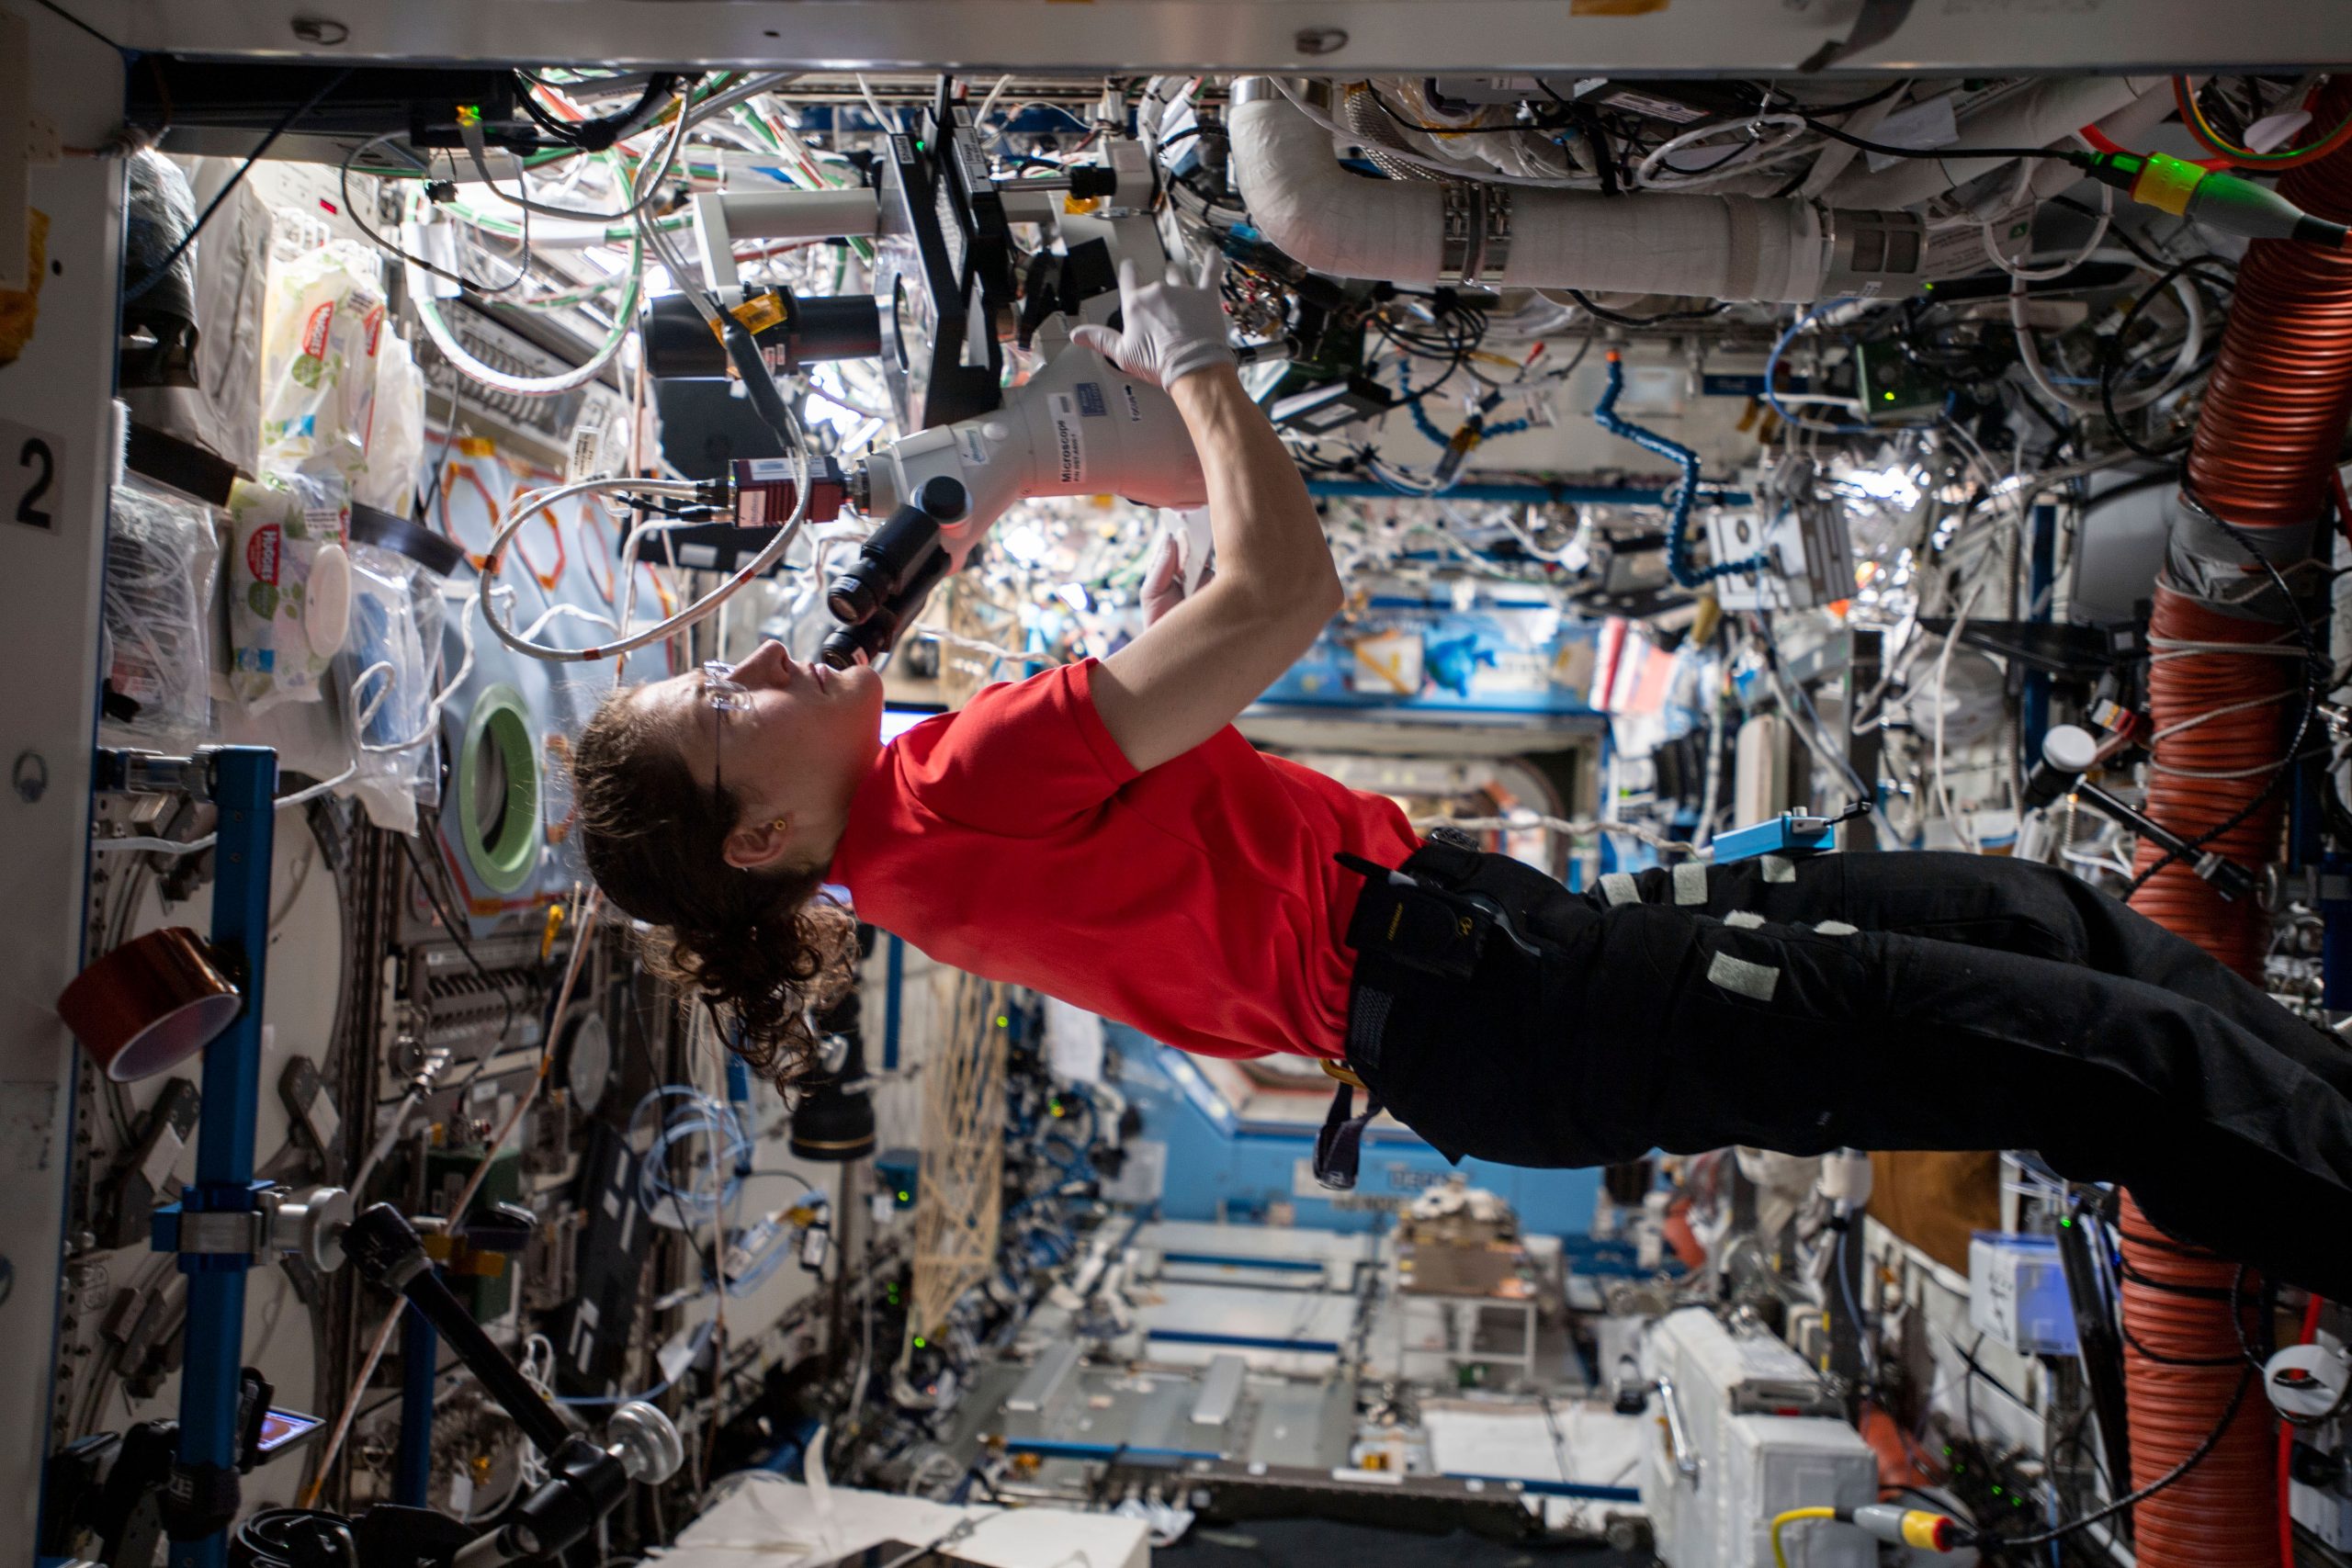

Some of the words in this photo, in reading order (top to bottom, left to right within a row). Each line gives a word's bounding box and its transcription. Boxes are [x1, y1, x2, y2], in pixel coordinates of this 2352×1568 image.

[897, 138, 910, 162] Shield
[1057, 420, 1072, 482] Microscope
[17, 438, 52, 528] 2
[262, 530, 277, 581] HUGGIES
